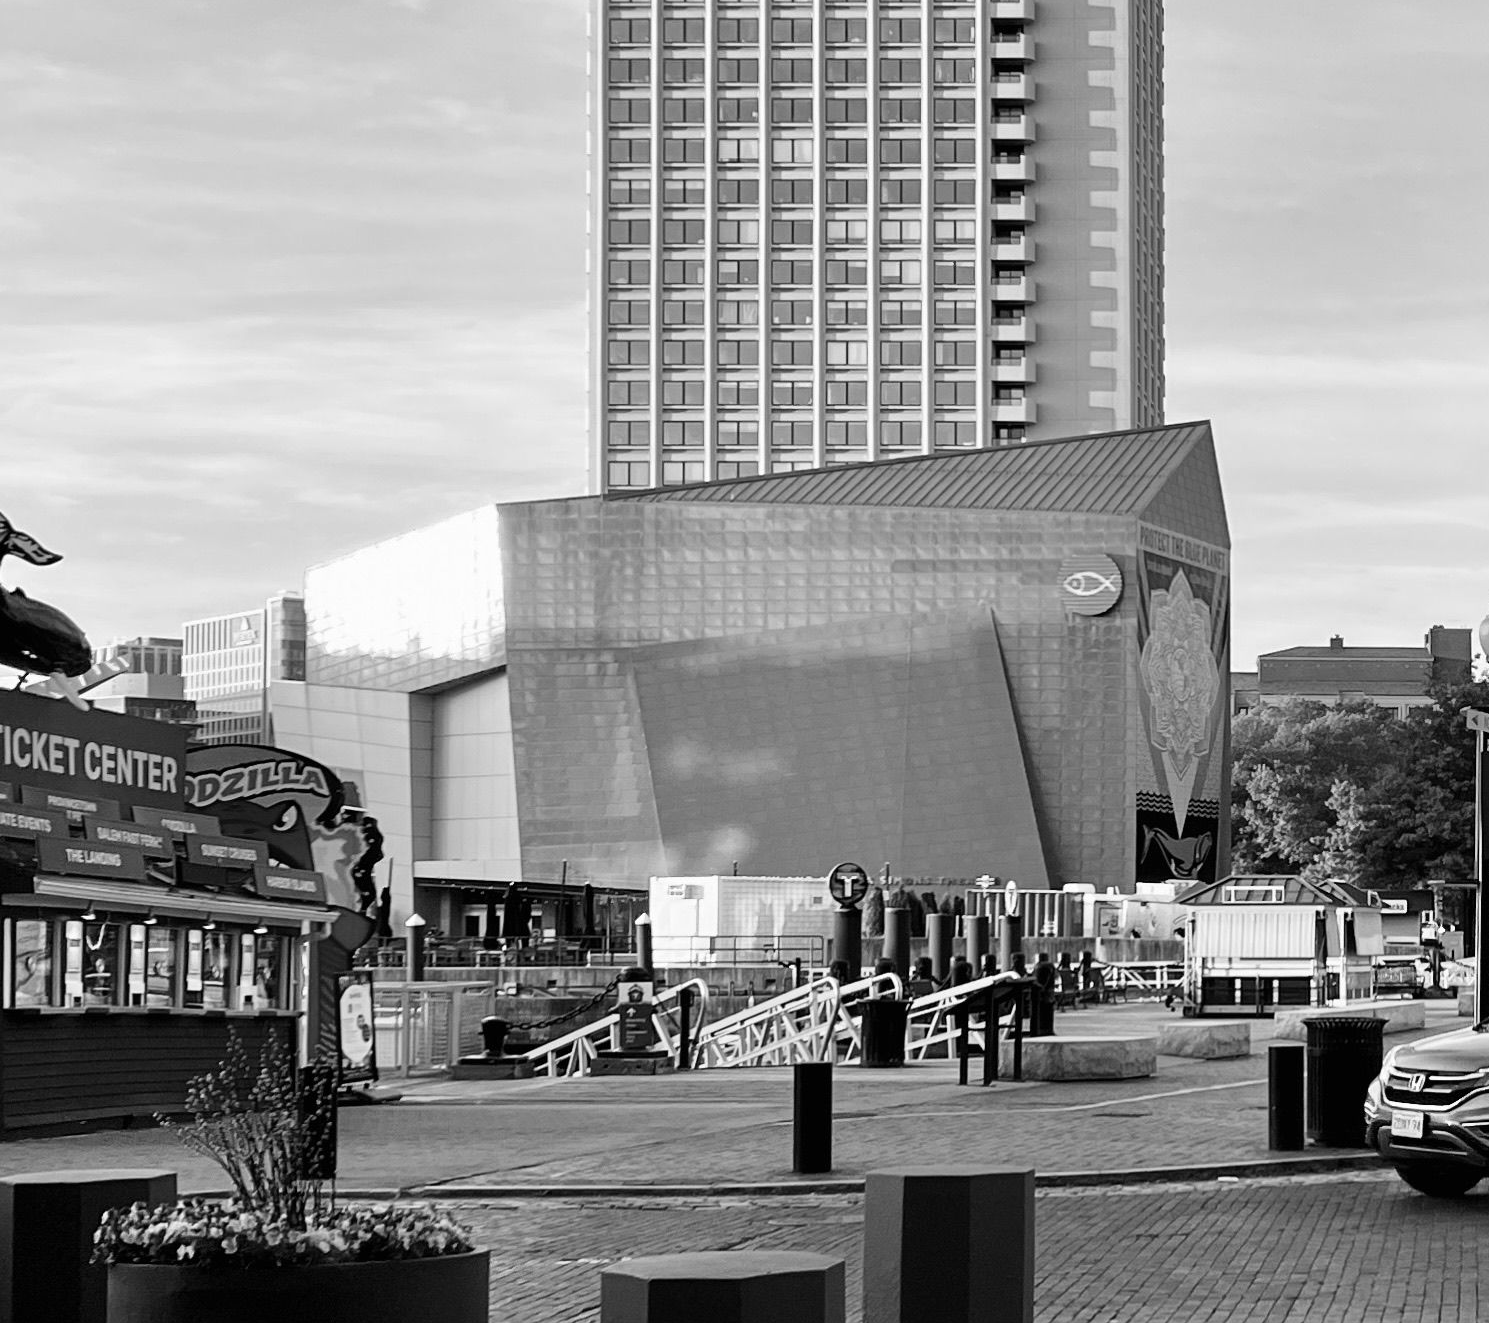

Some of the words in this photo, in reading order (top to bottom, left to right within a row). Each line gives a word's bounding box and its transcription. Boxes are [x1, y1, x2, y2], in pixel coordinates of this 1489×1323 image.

[1141, 525, 1170, 555] PROTECT
[1171, 536, 1184, 558] THE
[1185, 540, 1202, 564] BLUE
[1202, 545, 1226, 572] PLANET
[84, 741, 178, 793] CENTER
[65, 848, 84, 863] THE
